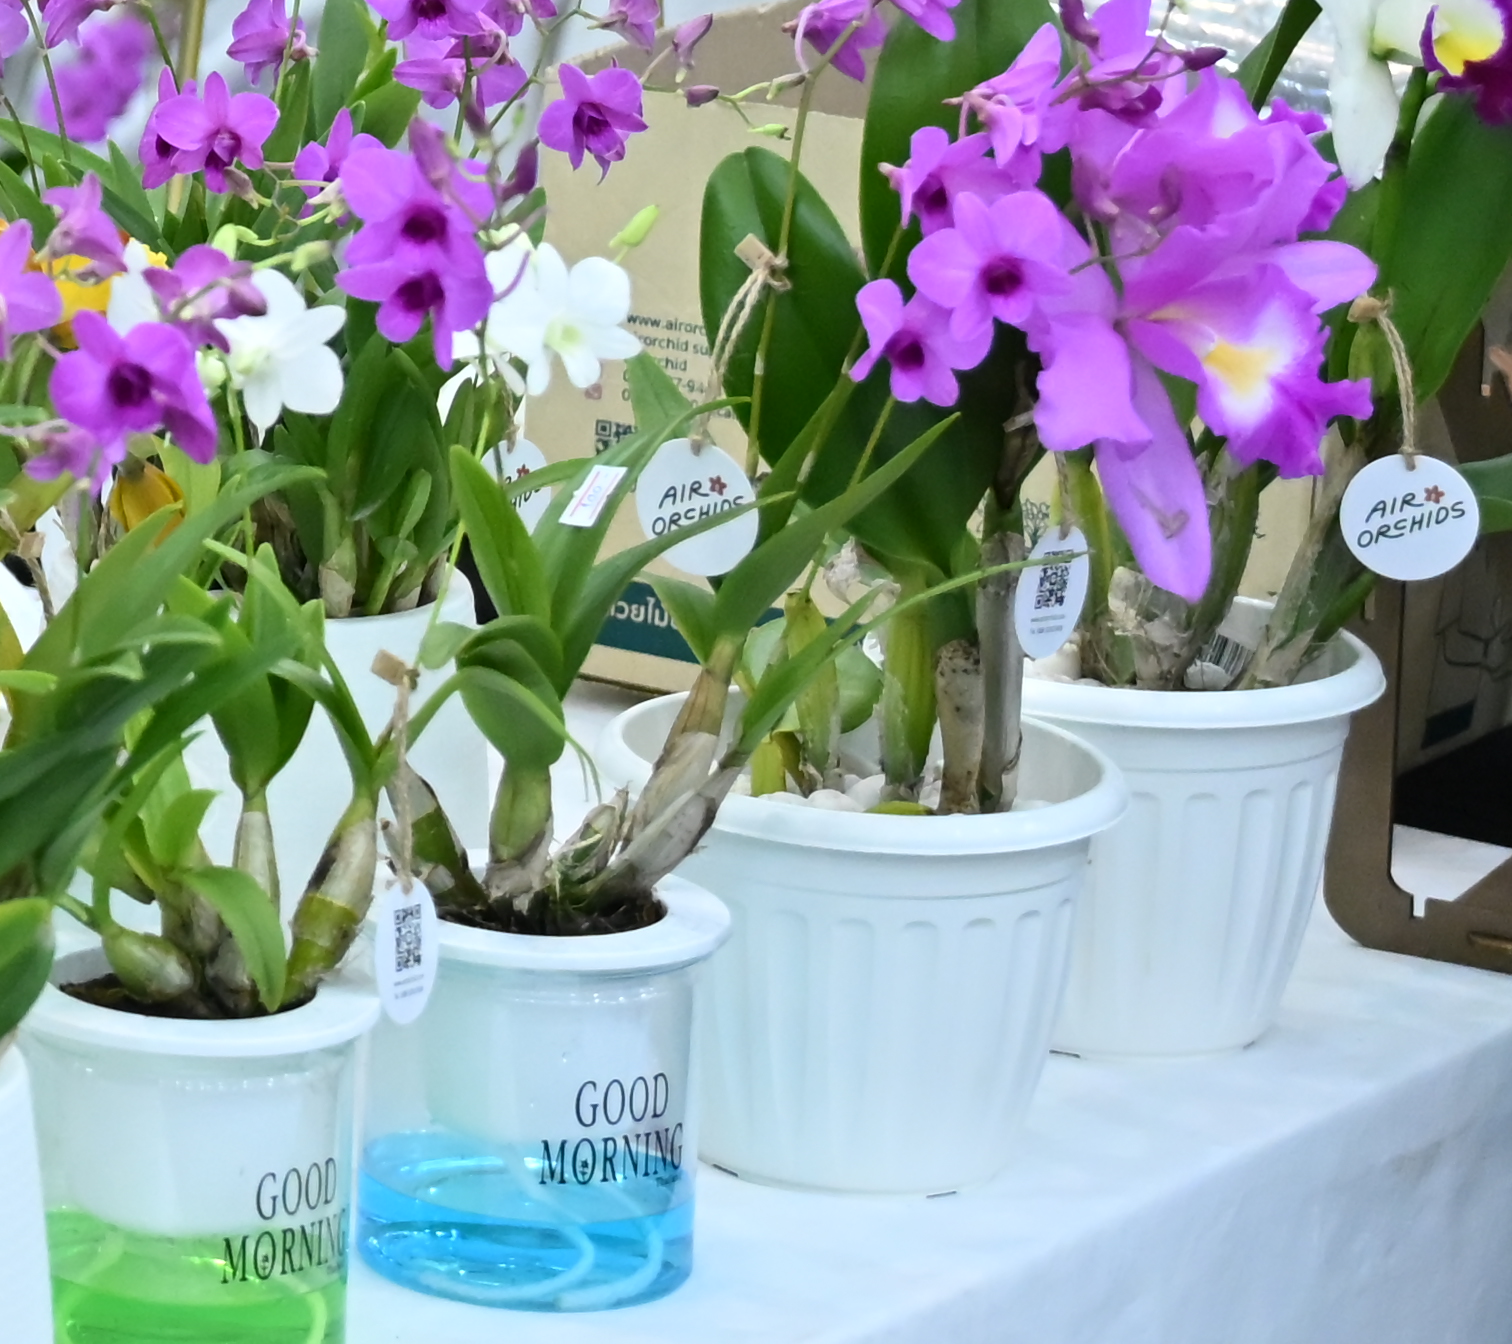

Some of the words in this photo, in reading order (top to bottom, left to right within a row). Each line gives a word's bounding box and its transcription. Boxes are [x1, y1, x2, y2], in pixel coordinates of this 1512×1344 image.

[658, 480, 710, 510] AIR
[1365, 492, 1425, 523] AIR
[1357, 500, 1466, 548] ORCHIDS
[574, 1072, 669, 1128] GOOD
[539, 1122, 684, 1185] MORNING
[256, 1157, 337, 1220] GOOD
[220, 1207, 347, 1285] MORNING
